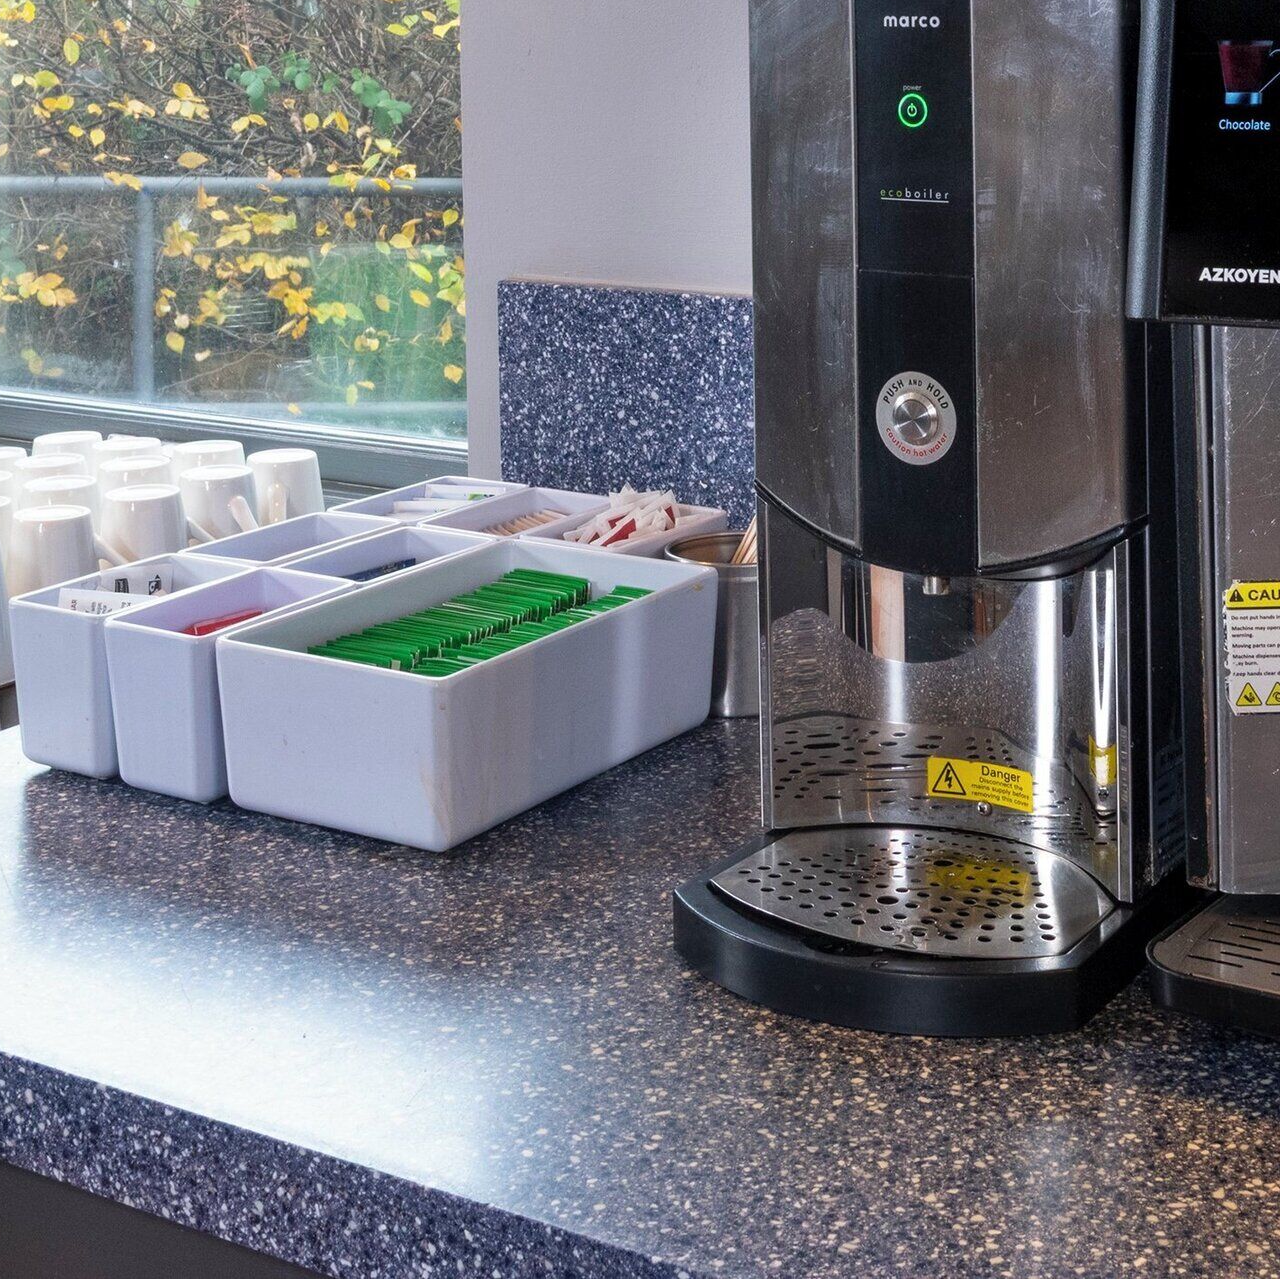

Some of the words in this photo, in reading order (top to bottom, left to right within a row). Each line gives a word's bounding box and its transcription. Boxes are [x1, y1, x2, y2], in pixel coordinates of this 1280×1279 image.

[883, 15, 940, 28] marco
[1218, 118, 1271, 131] Chocolate
[880, 187, 949, 200] ecoboiler
[883, 380, 904, 404] PUSH
[908, 379, 922, 387] AND
[926, 383, 949, 409] HOLD
[886, 427, 911, 454] caution
[913, 449, 927, 457] hot
[928, 433, 948, 454] water
[982, 766, 1020, 783] Danger
